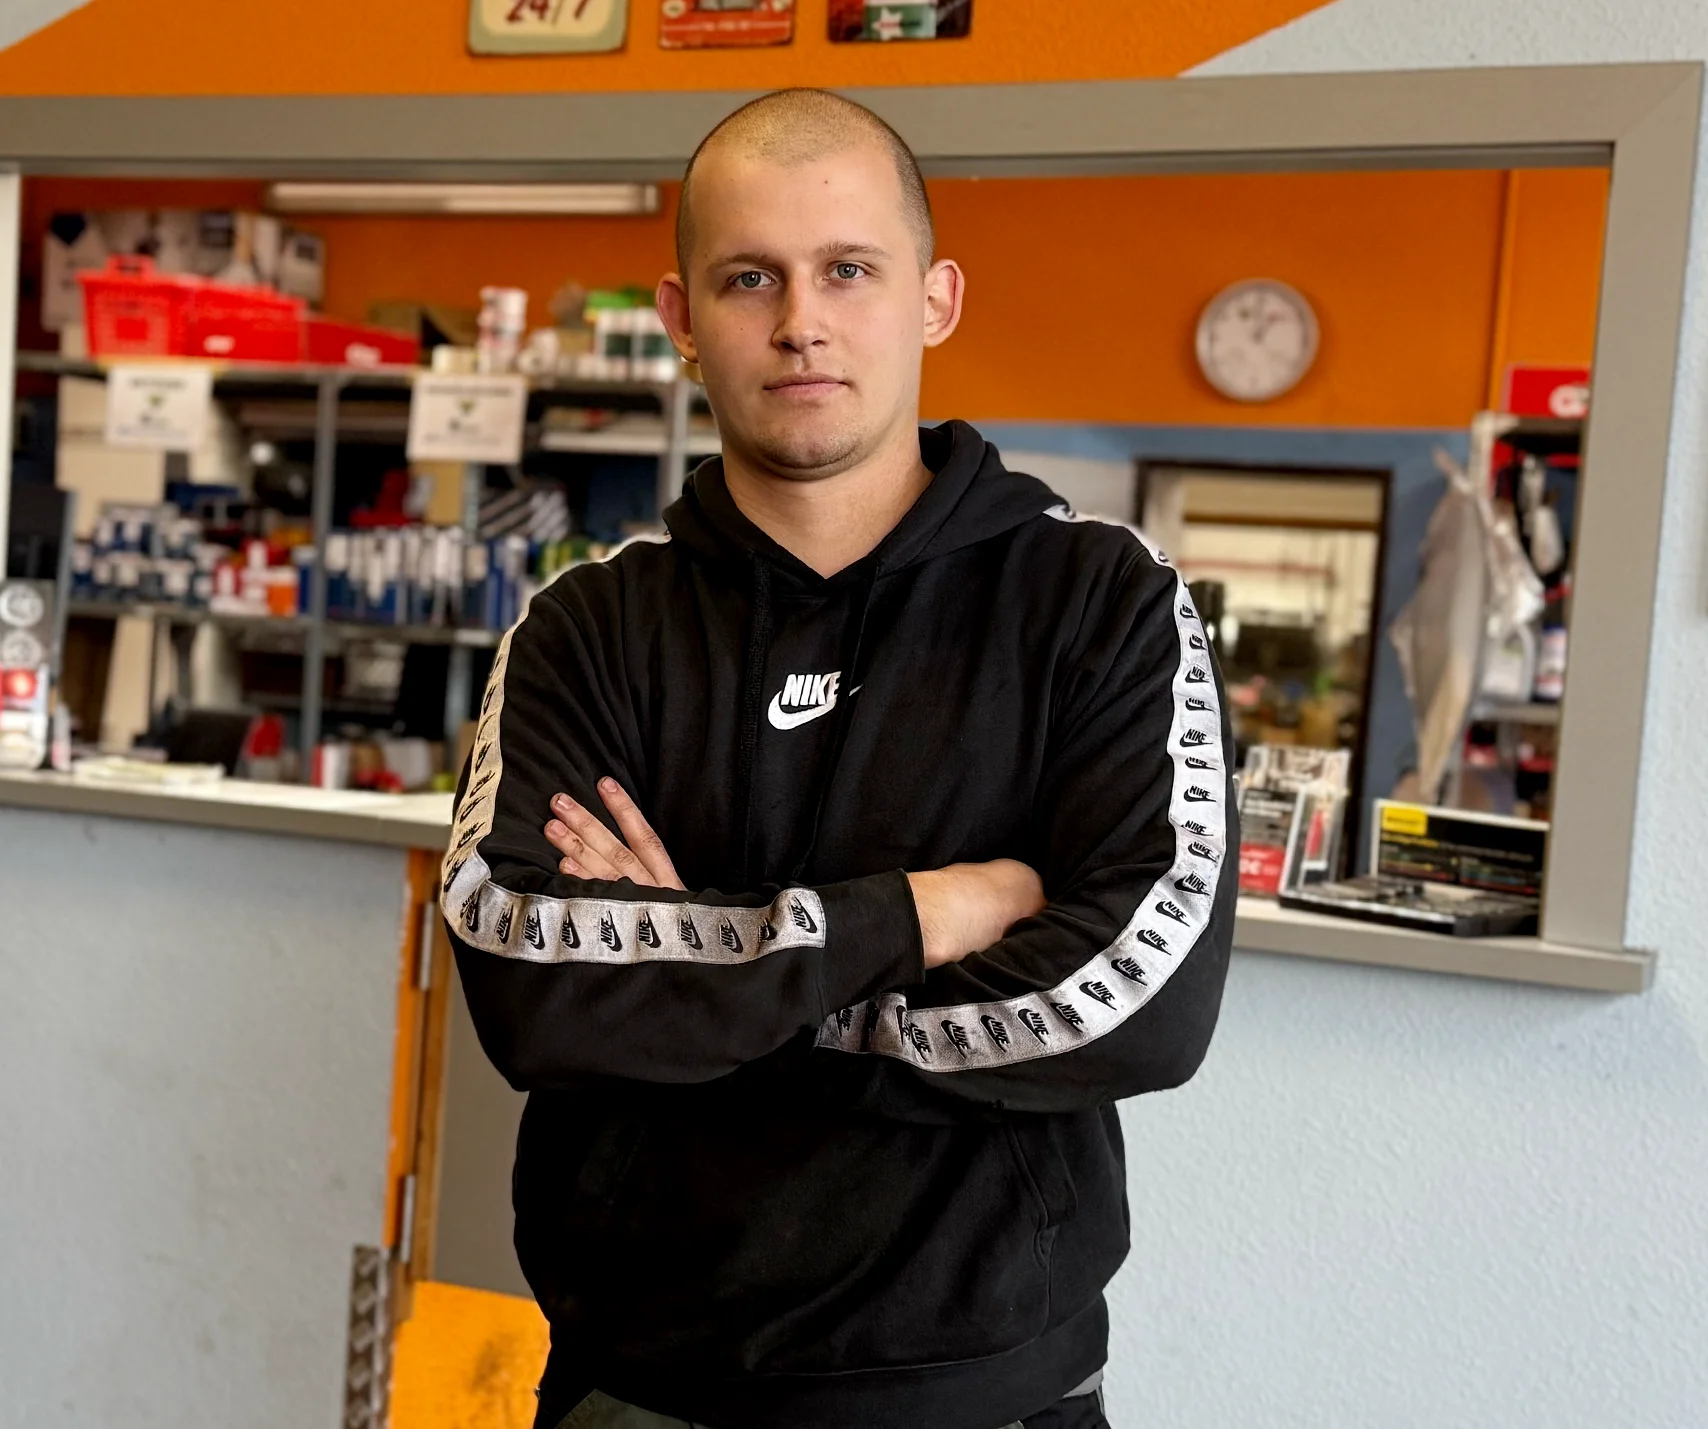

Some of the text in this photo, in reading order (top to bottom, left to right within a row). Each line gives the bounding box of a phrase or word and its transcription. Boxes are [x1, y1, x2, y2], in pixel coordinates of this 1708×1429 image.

[781, 671, 841, 707] NIKE
[1185, 729, 1207, 742] NIKE
[1189, 786, 1210, 799] NIKE
[1185, 872, 1207, 891] NIKE
[1165, 901, 1187, 919] NIKE
[524, 914, 538, 943] NIKE
[1145, 929, 1169, 948] NIKE
[1120, 958, 1145, 979] NIKE
[1091, 981, 1115, 1002] NIKE
[1029, 1012, 1049, 1037] NIKE
[1061, 1004, 1084, 1026] NIKE
